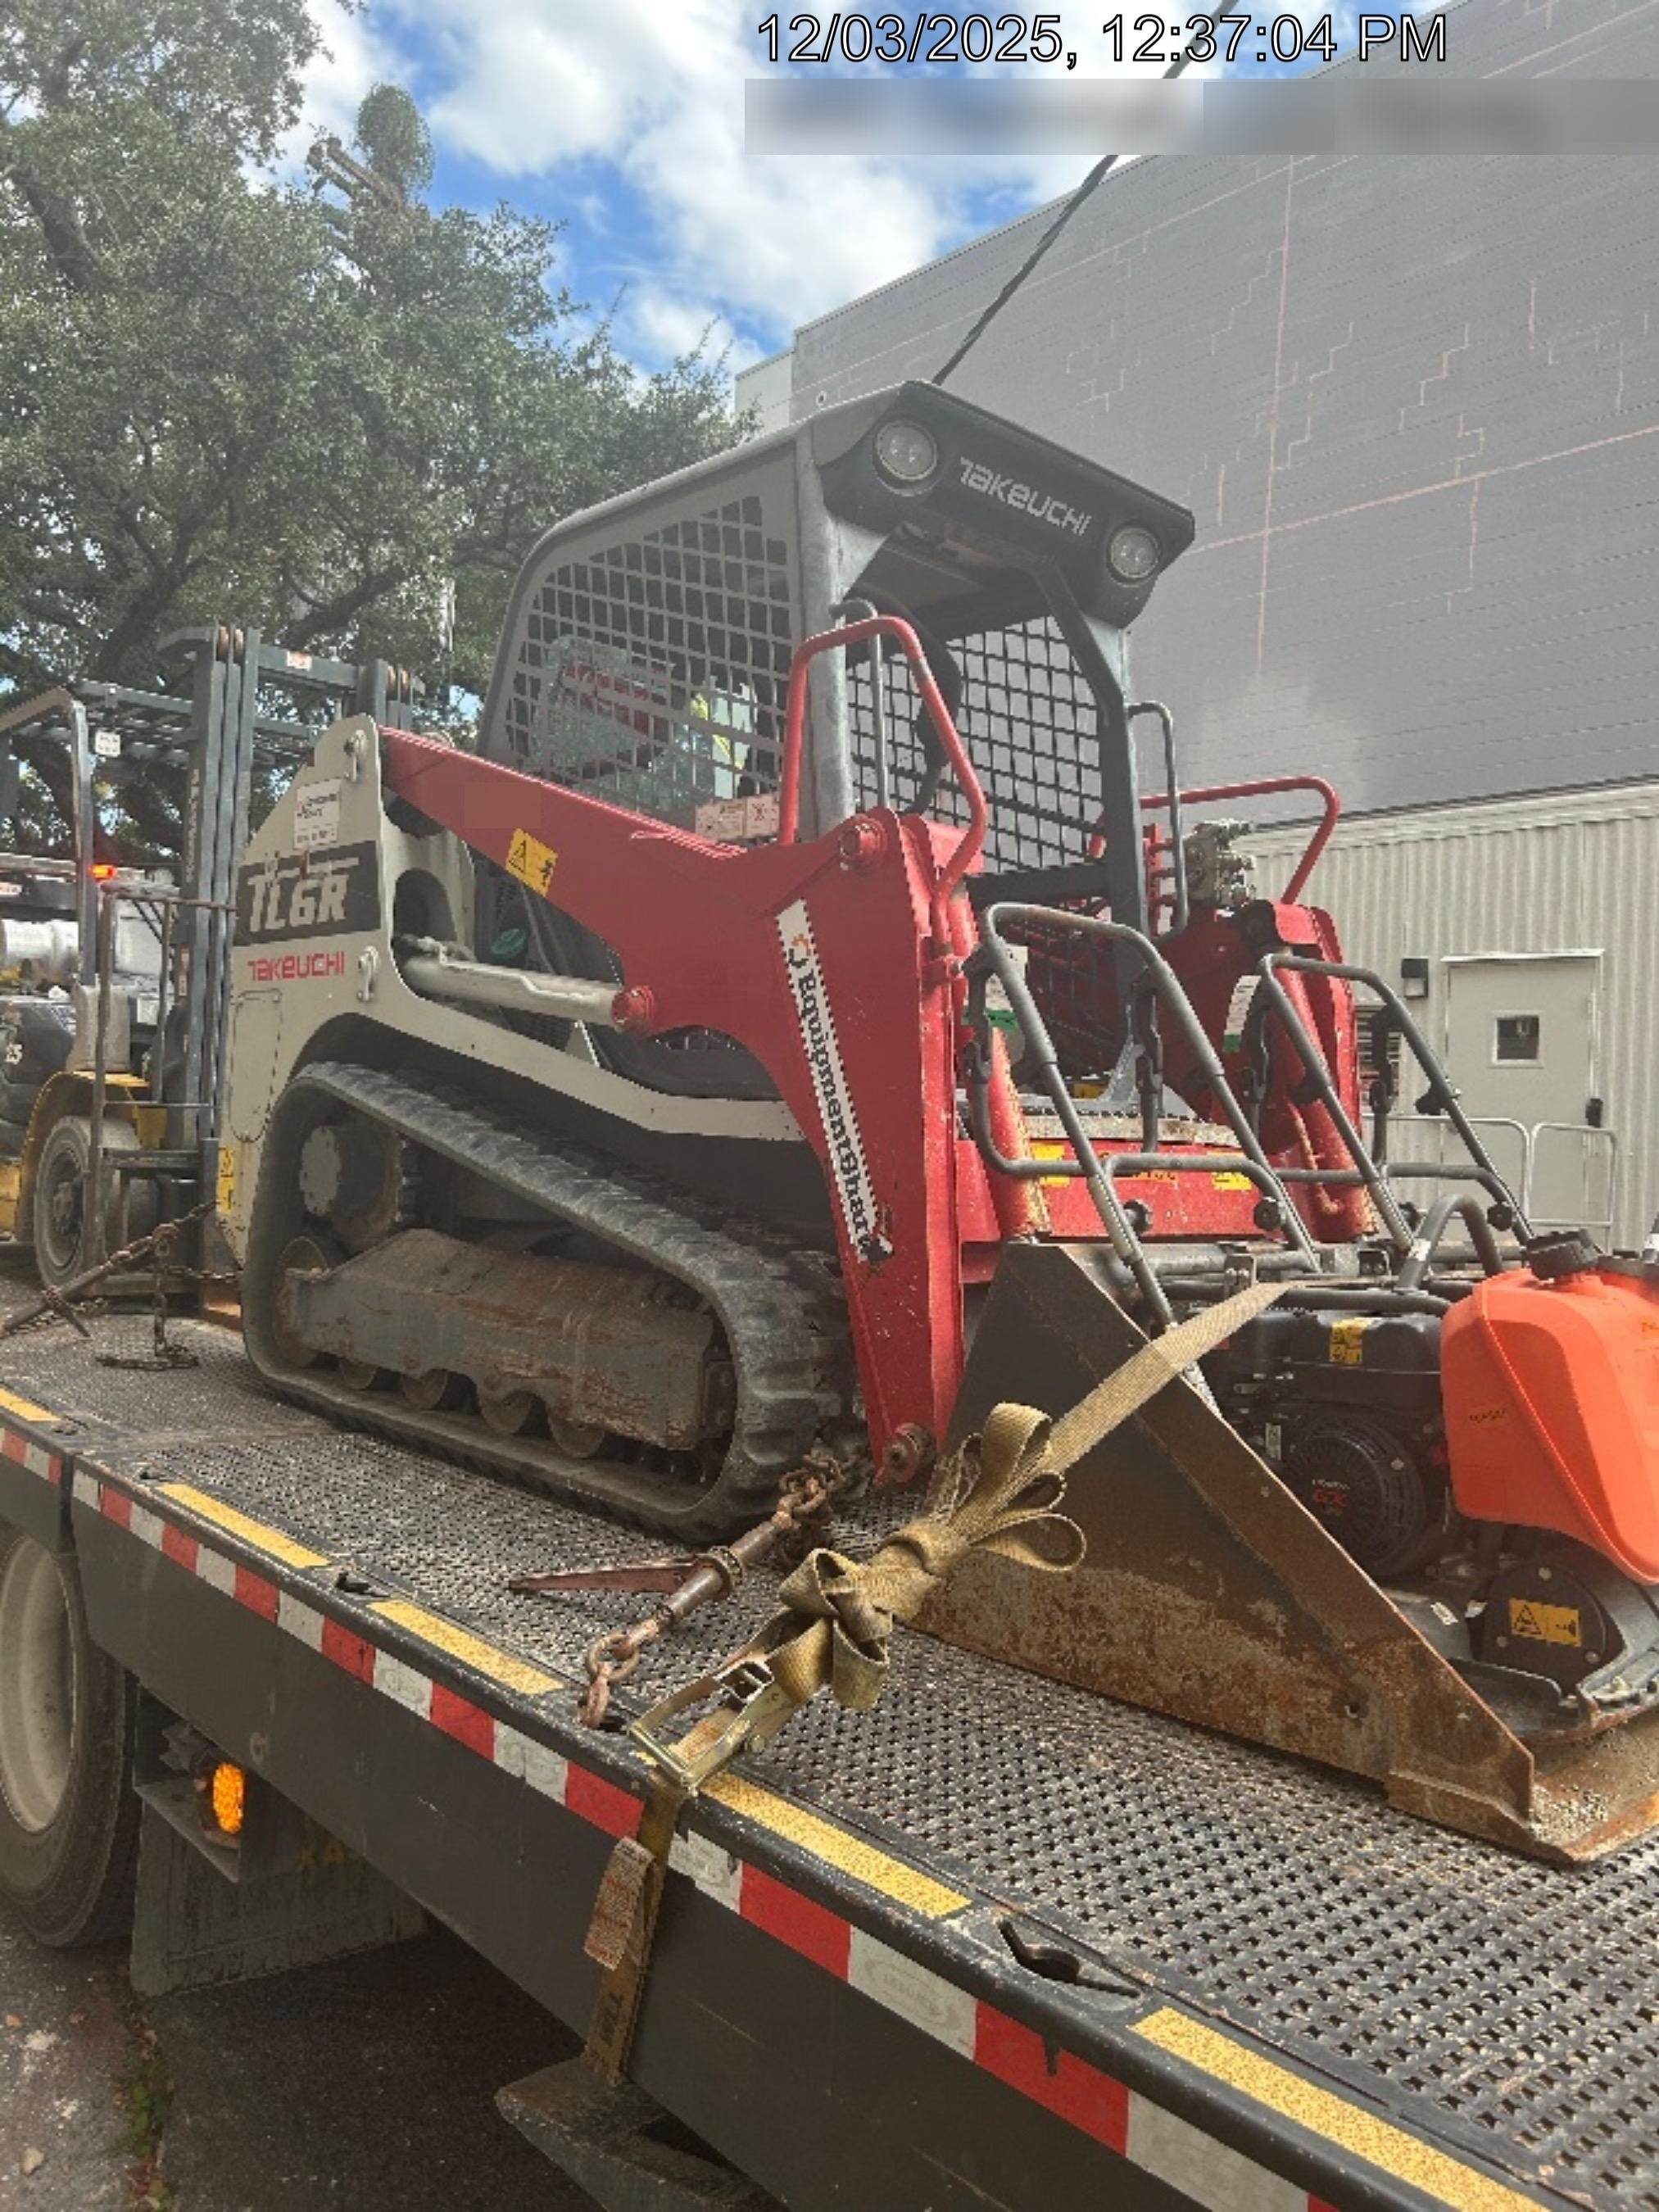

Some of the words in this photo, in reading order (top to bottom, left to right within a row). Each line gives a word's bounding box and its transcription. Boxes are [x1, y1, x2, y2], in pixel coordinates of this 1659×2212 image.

[959, 455, 1092, 537] TAKEUCHI
[247, 872, 350, 932] TL6R
[247, 950, 345, 981] TAKEUCHI
